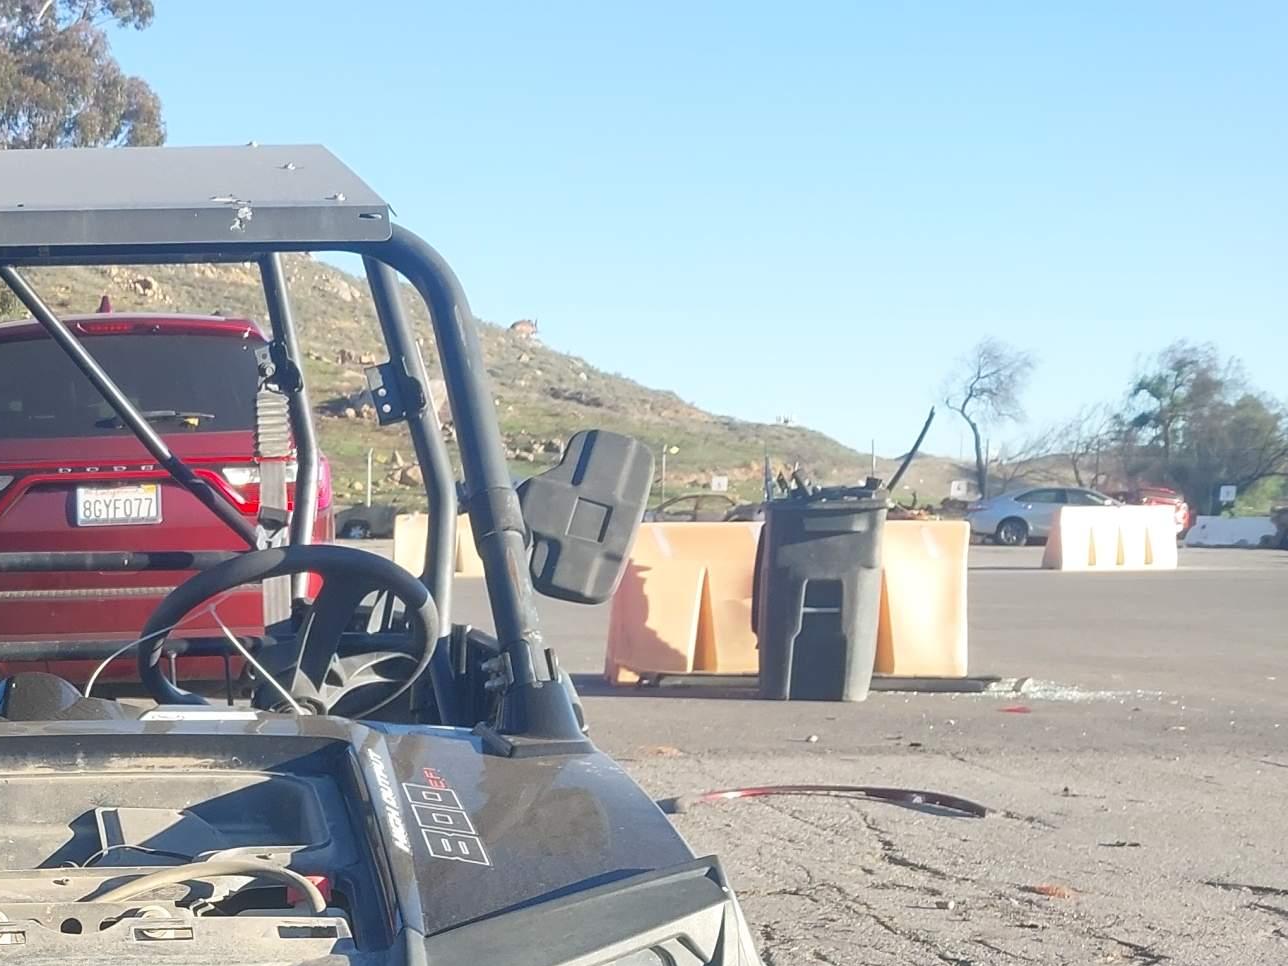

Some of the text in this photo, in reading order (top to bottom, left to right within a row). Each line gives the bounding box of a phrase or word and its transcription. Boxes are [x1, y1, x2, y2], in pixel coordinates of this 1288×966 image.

[82, 497, 154, 520] 8GYF077
[367, 748, 414, 857] HIGH OUTPUT
[402, 767, 493, 867] 800 EFI
